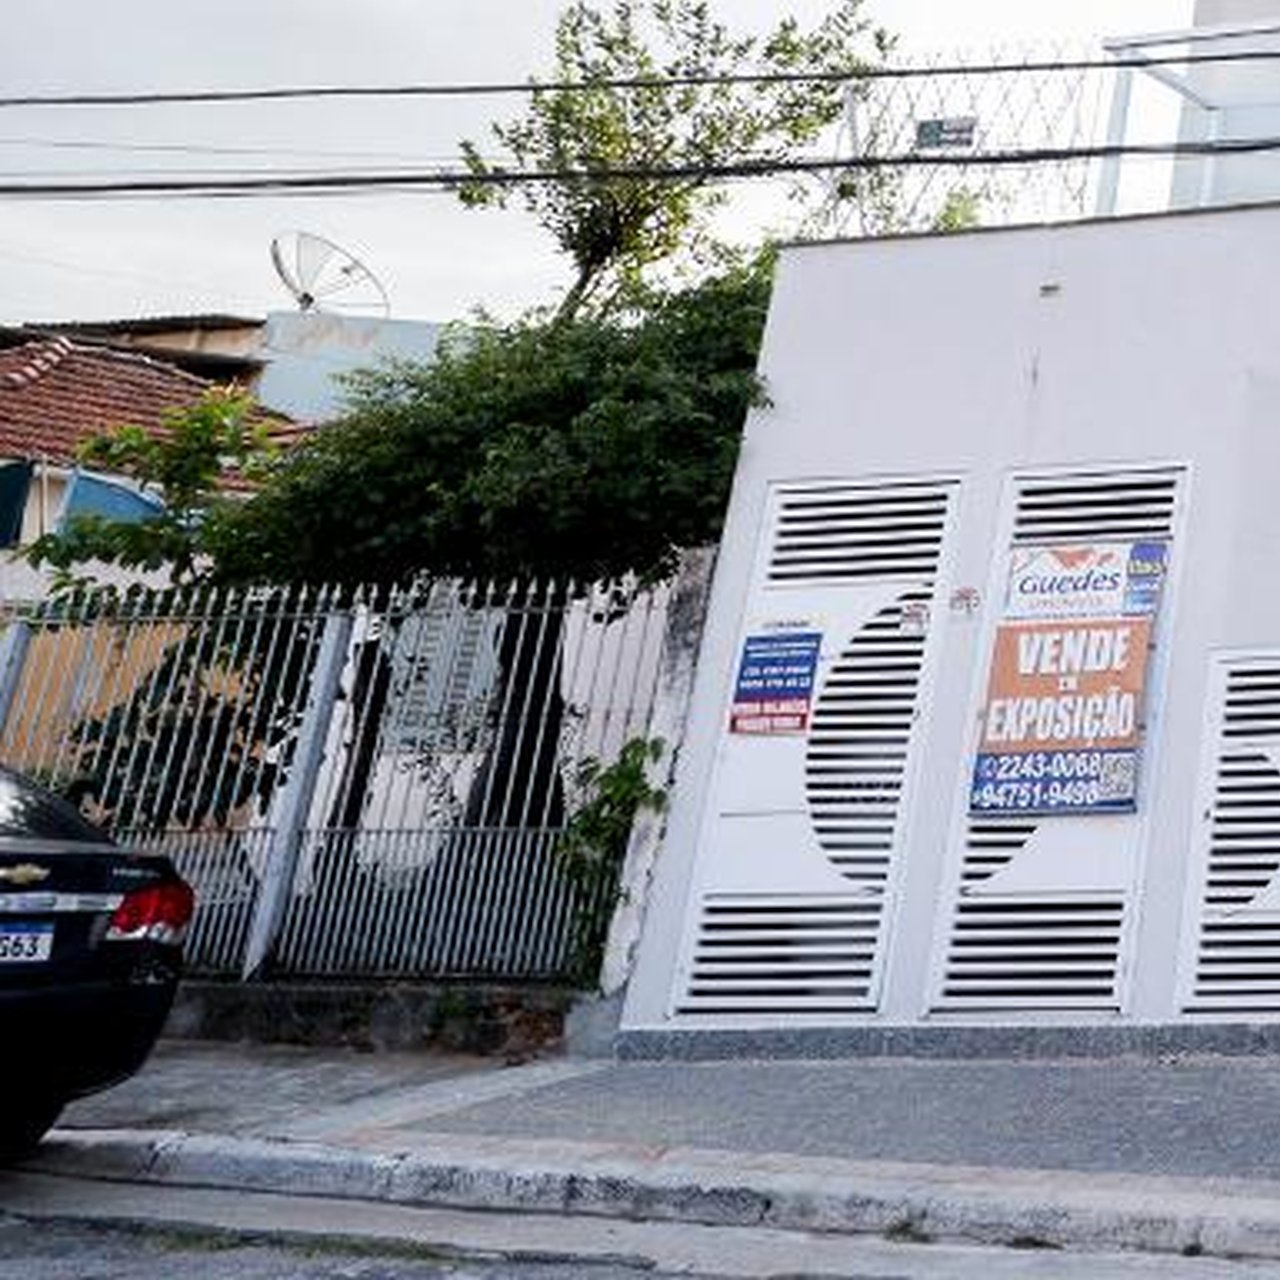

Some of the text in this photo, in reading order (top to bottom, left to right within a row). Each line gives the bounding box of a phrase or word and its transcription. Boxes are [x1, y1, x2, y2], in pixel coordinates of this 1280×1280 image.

[1019, 569, 1122, 595] Guedes
[1018, 629, 1131, 673] VENDE
[986, 686, 1134, 748] EXPOSIÇÃO
